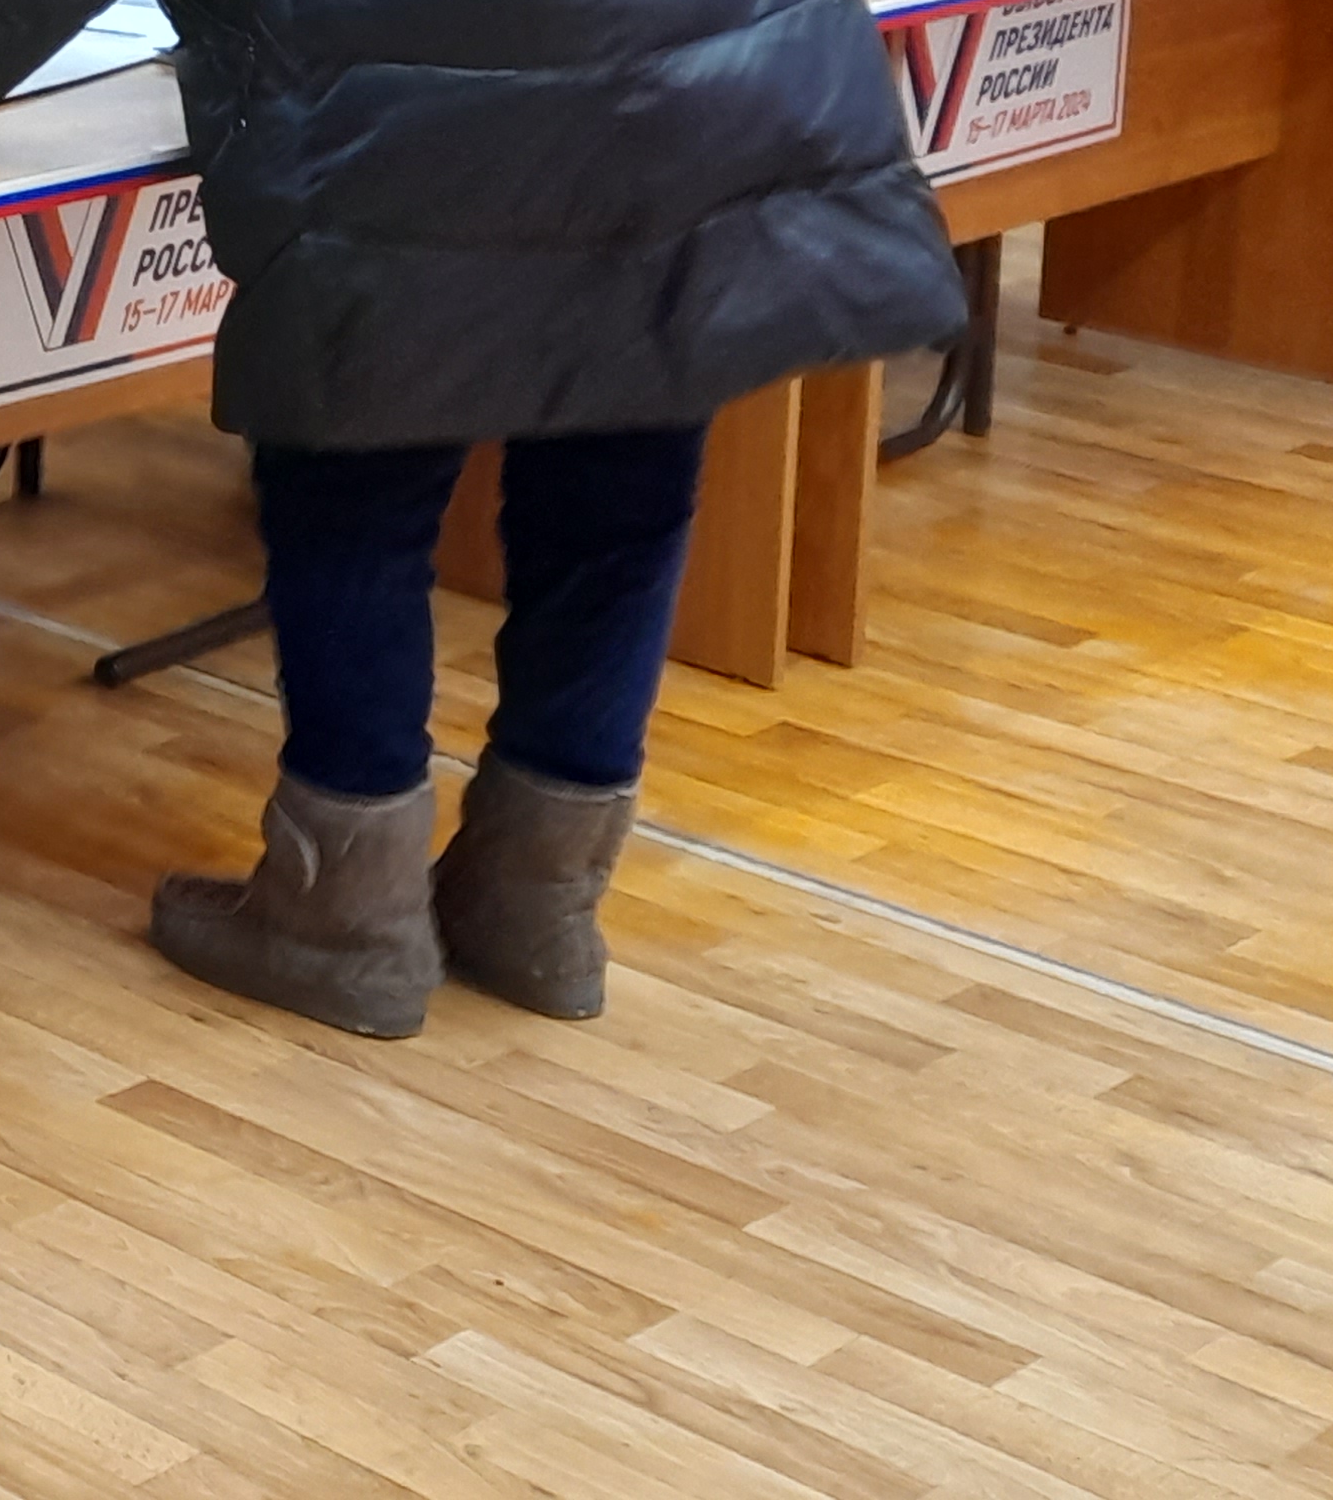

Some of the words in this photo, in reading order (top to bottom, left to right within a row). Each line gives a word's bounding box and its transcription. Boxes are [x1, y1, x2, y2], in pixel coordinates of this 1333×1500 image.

[988, 2, 1115, 62] ПРЕЗИДЕНТА
[976, 57, 1060, 106] РОССИИ
[1006, 98, 1056, 133] МАРТА
[133, 235, 213, 288] РОСС
[180, 278, 231, 319] МАР
